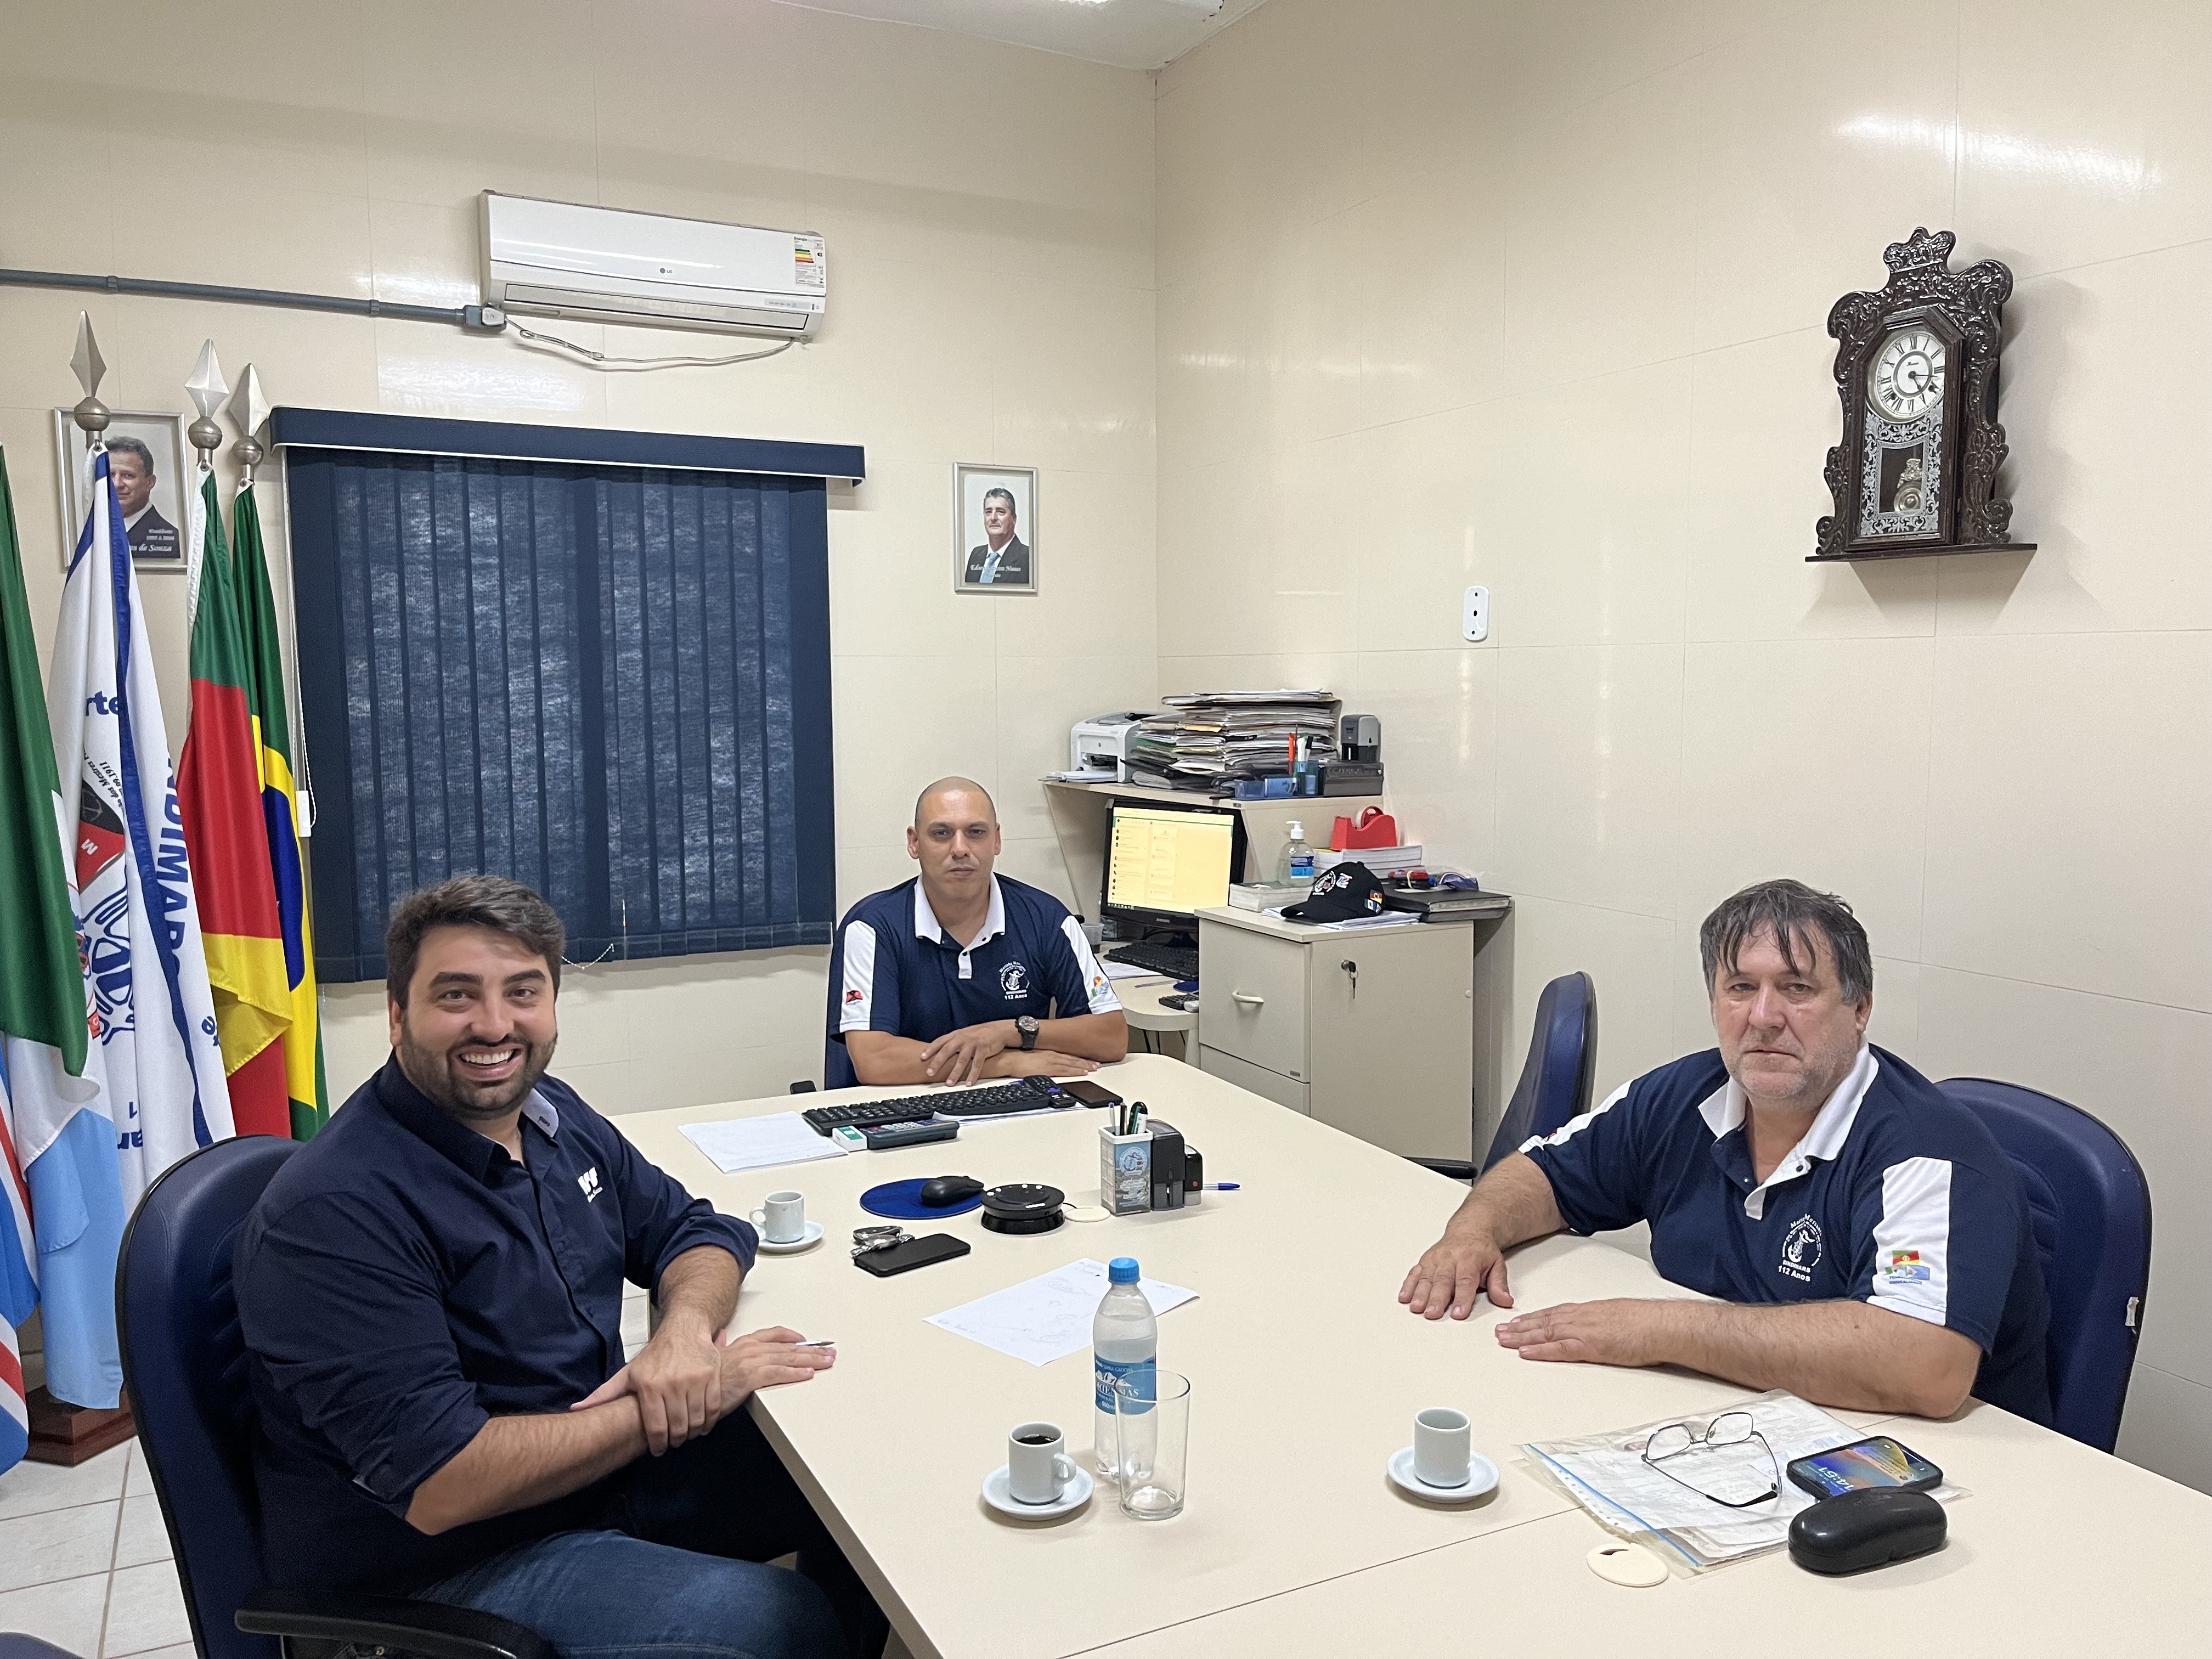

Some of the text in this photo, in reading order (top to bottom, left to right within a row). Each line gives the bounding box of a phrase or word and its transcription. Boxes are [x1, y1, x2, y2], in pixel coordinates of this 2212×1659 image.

[1778, 1265, 1811, 1282] 112 Anos
[1818, 1466, 1854, 1491] 14:51
